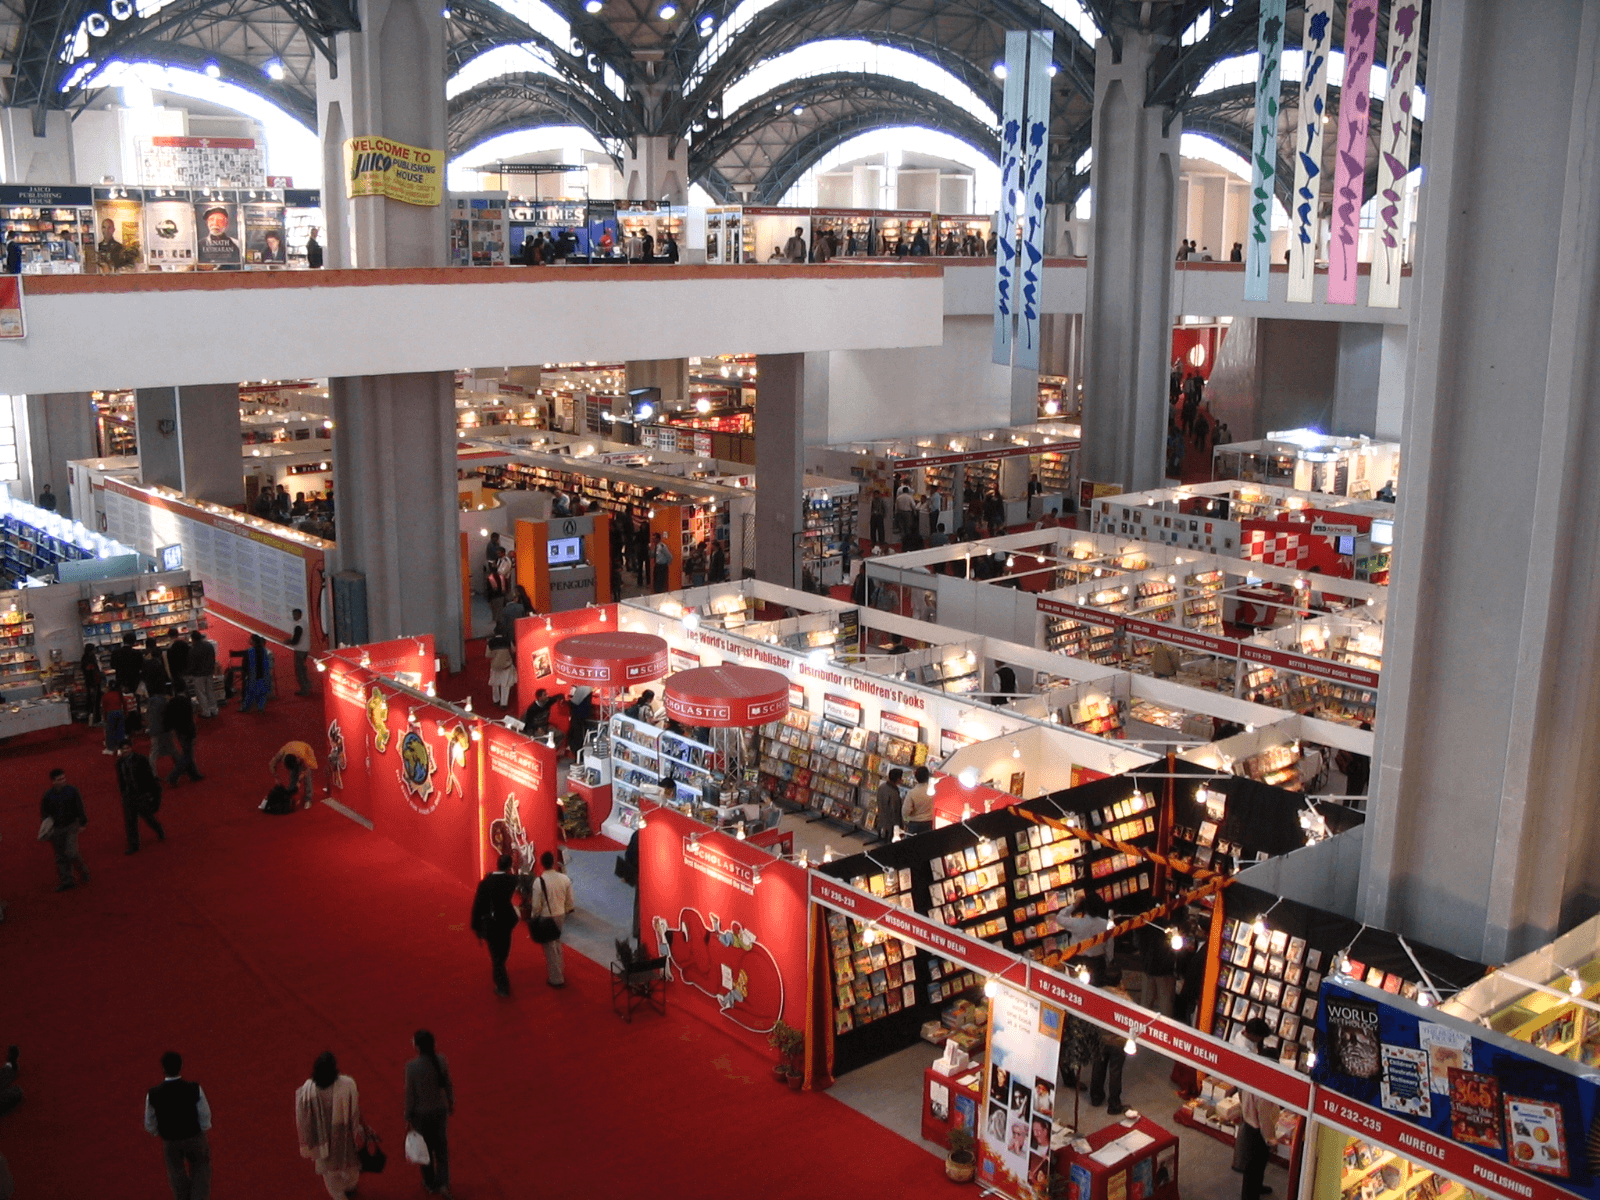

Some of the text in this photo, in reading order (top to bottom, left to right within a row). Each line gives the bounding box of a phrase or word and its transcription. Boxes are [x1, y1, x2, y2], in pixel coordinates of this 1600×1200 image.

[350, 140, 431, 163] WELCOME TO
[393, 159, 436, 174] PUBLISHING
[396, 169, 424, 184] HOUSE
[536, 206, 585, 220] TIMES
[550, 578, 595, 591] PENGUIN
[700, 631, 726, 650] World's
[754, 648, 791, 668] Publisher
[799, 662, 843, 685] Distributor
[853, 677, 897, 702] Children's
[693, 849, 751, 880] SCHOLASTIC
[885, 914, 911, 933] WISDOM
[930, 933, 946, 946] NEW
[946, 939, 967, 956] DELHI
[1327, 1004, 1379, 1024] WORLD
[1328, 1016, 1379, 1031] MYTHOLOGY
[1113, 1011, 1147, 1034] WISDOM
[1172, 1036, 1192, 1053] NEW
[1193, 1046, 1219, 1064] DELHI
[1454, 1078, 1492, 1107] 365
[1340, 1105, 1383, 1133] 232-235
[1398, 1132, 1446, 1160] AUREOLE
[1473, 1163, 1533, 1198] PUBLISHING
